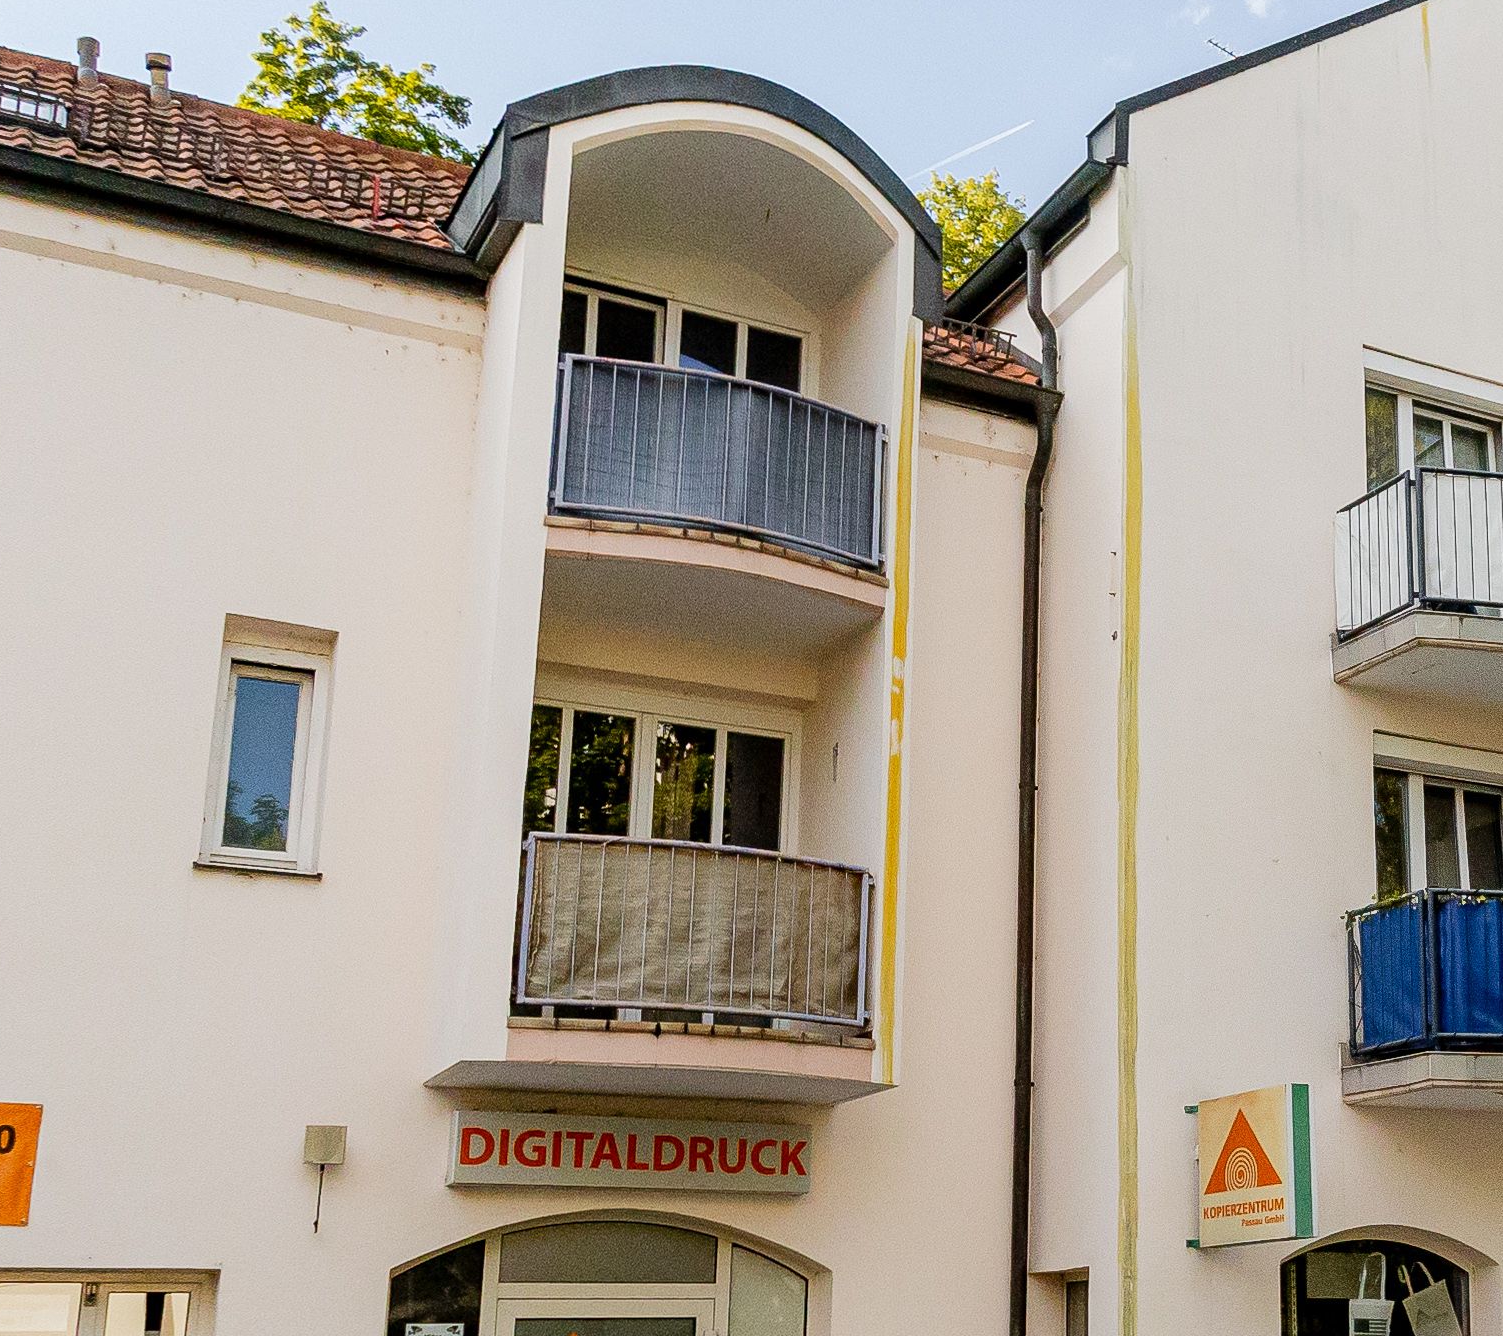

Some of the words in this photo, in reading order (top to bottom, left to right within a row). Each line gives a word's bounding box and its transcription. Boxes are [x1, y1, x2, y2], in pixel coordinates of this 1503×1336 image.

[458, 1127, 809, 1177] DIGITALDRUCK
[1203, 1198, 1285, 1220] KOPIERZENTRUM
[1241, 1218, 1263, 1227] Passau
[1264, 1214, 1285, 1224] GmbH
